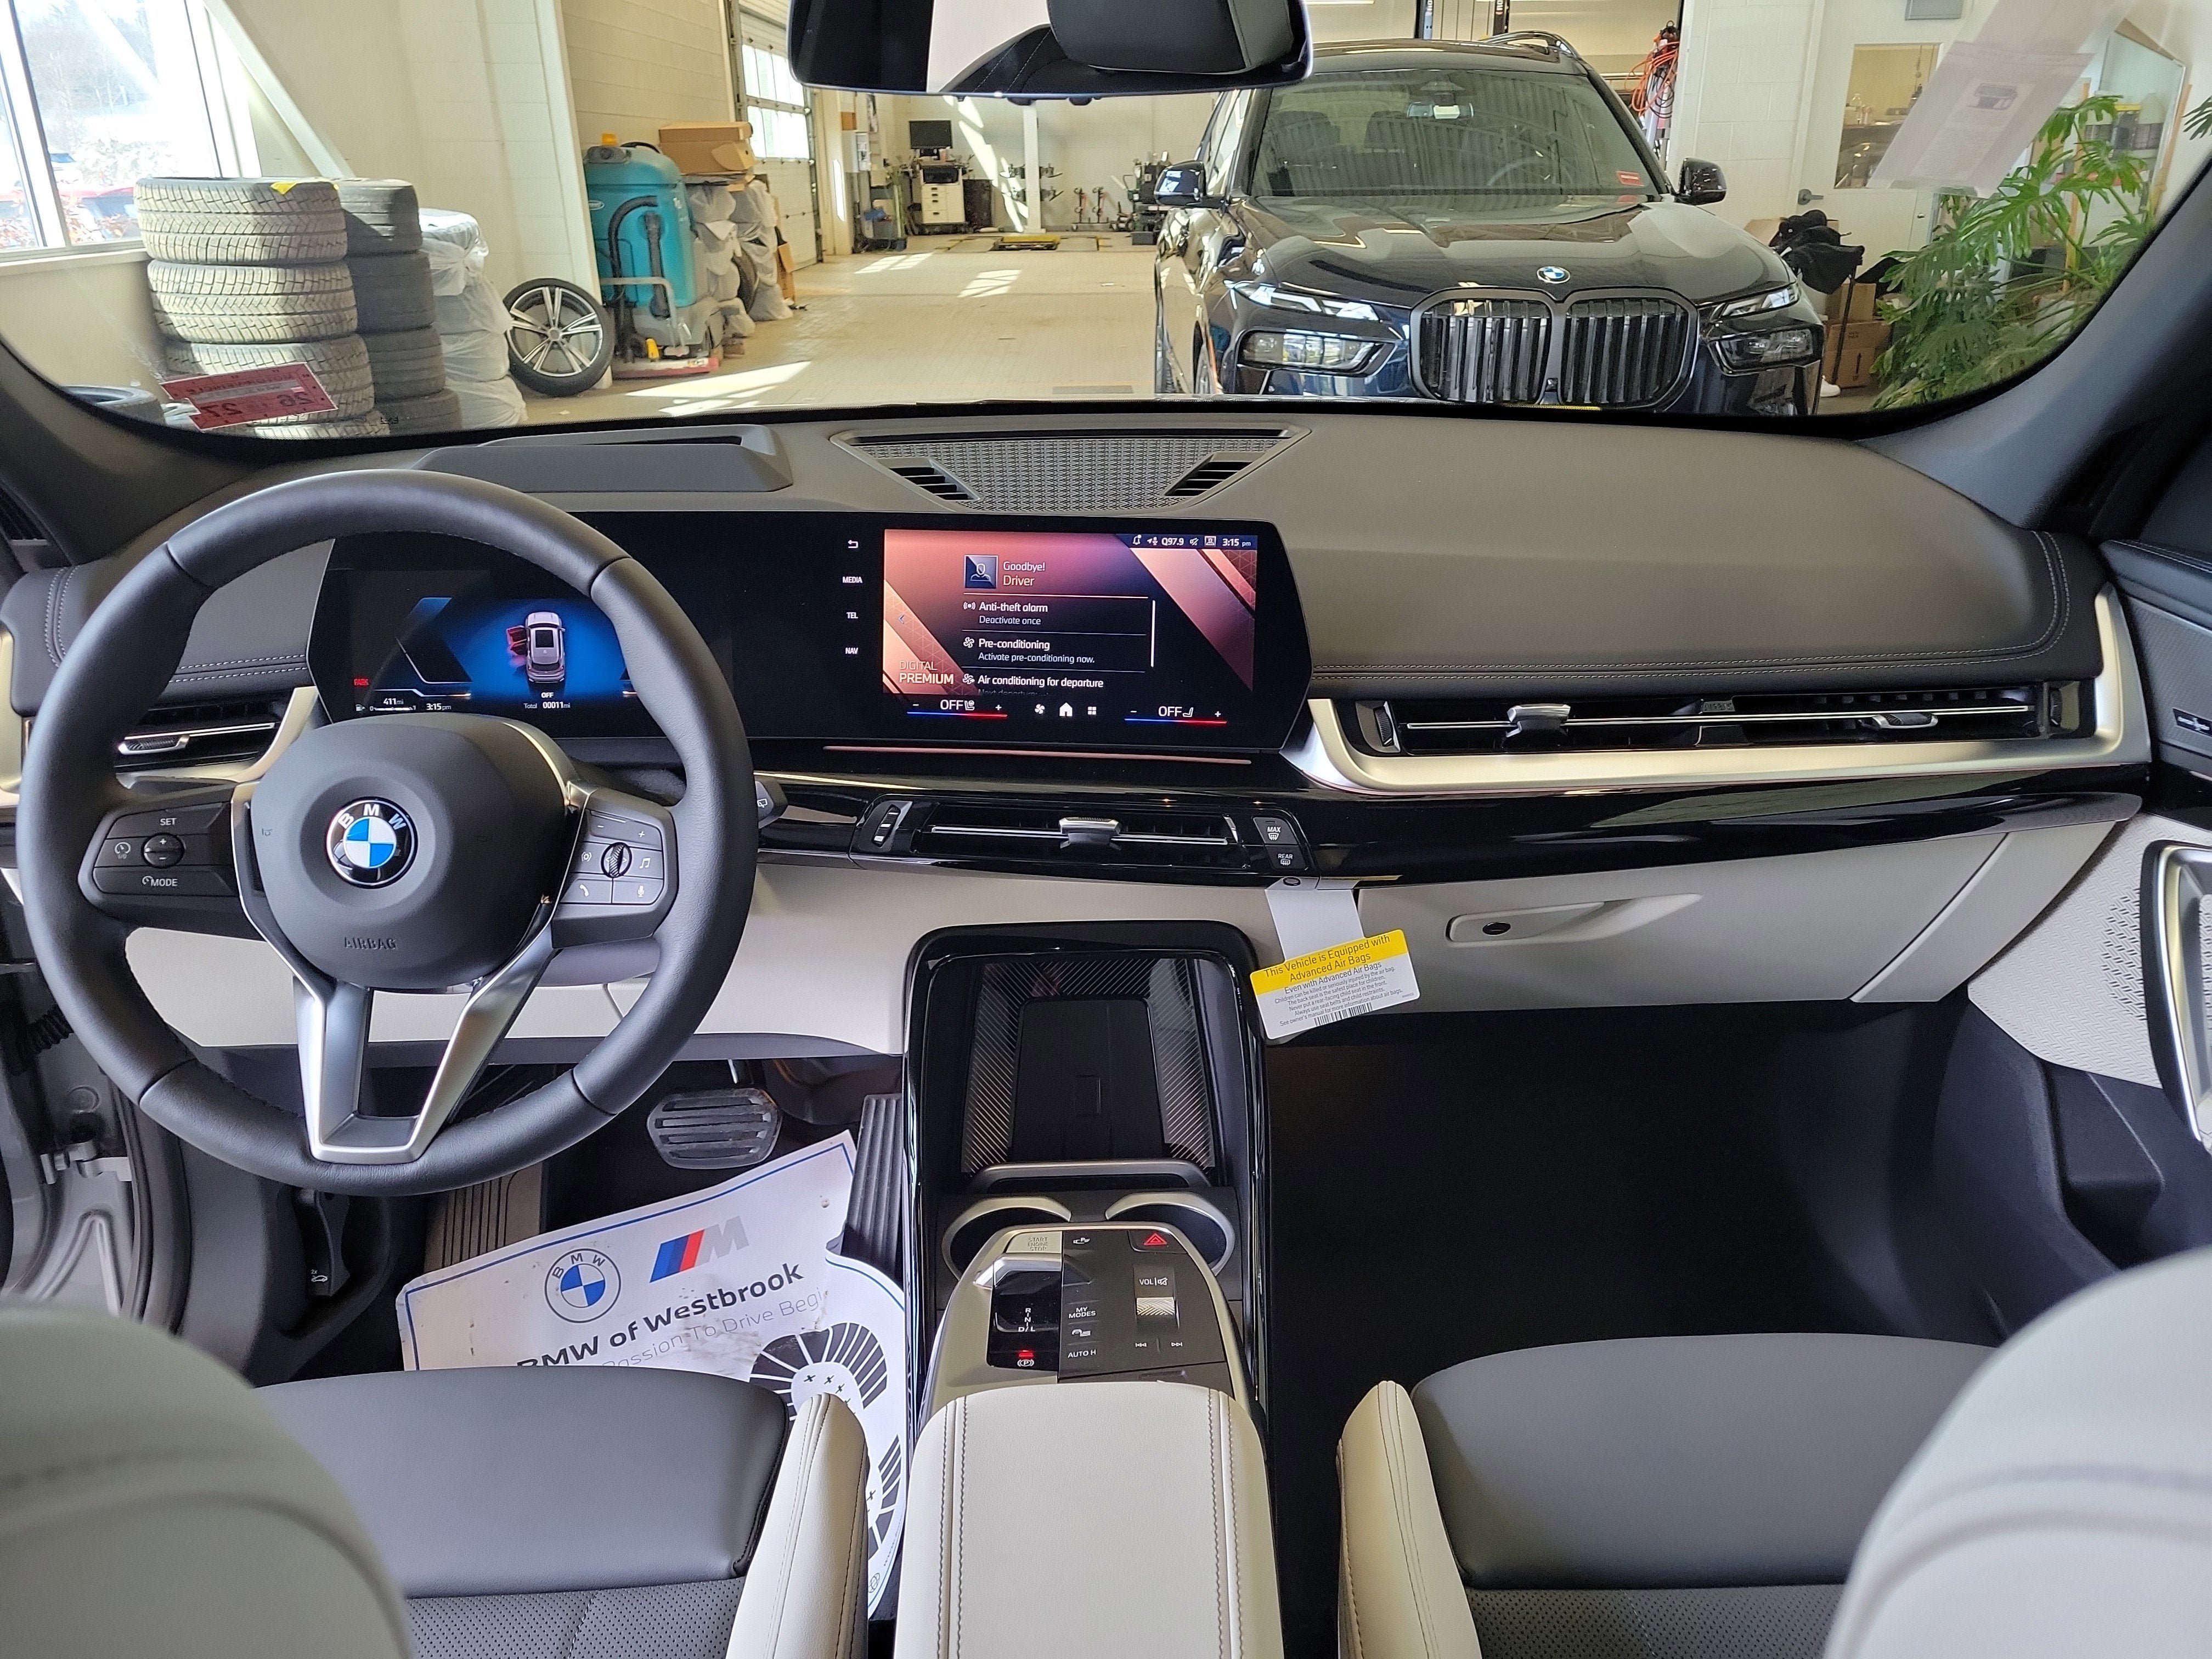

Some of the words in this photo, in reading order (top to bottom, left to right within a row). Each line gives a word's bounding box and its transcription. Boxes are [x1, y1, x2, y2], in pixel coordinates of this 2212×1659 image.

[1161, 537, 1184, 546] Q97.9
[1222, 538, 1240, 546] 3:15
[1003, 561, 1046, 573] Goodbye!
[1003, 575, 1035, 586] Driver
[979, 601, 1021, 612] Anti-theft
[1022, 603, 1048, 613] alarm
[979, 615, 1020, 625] Deactivate
[978, 638, 1050, 651] Pre-conditioning
[978, 652, 1009, 661] Activate
[1011, 653, 1075, 664] pre-conditioning
[899, 661, 938, 670] DIGITAL
[899, 673, 955, 685] PREMIUM
[977, 675, 990, 684] Air
[992, 675, 1045, 687] conditioning
[1047, 676, 1059, 686] for
[1060, 678, 1104, 688] departure
[940, 699, 964, 710] OFF
[1158, 706, 1183, 717] OFF
[160, 817, 177, 826] SET
[337, 803, 407, 831] BMW
[151, 878, 178, 887] MODE
[344, 936, 397, 950] AIRBAG
[1264, 967, 1284, 978] This
[1283, 956, 1317, 971] Vehicle
[1318, 953, 1326, 962] is
[1327, 939, 1369, 959] Equipped
[1370, 934, 1390, 946] with
[1290, 962, 1332, 982] Advanced
[1335, 958, 1345, 969] Air
[1347, 953, 1370, 964] Bags
[1284, 985, 1302, 994] Even
[1302, 979, 1317, 989] with
[1318, 968, 1352, 984] Advanced
[1363, 962, 1381, 971] Bags
[552, 1252, 606, 1279] BMW
[610, 1321, 638, 1347] of
[642, 1262, 804, 1333] Westbrook
[1068, 1310, 1096, 1319] MODES
[690, 1324, 716, 1341] To
[722, 1310, 774, 1333] Drive
[1067, 1350, 1089, 1358] AUTO
